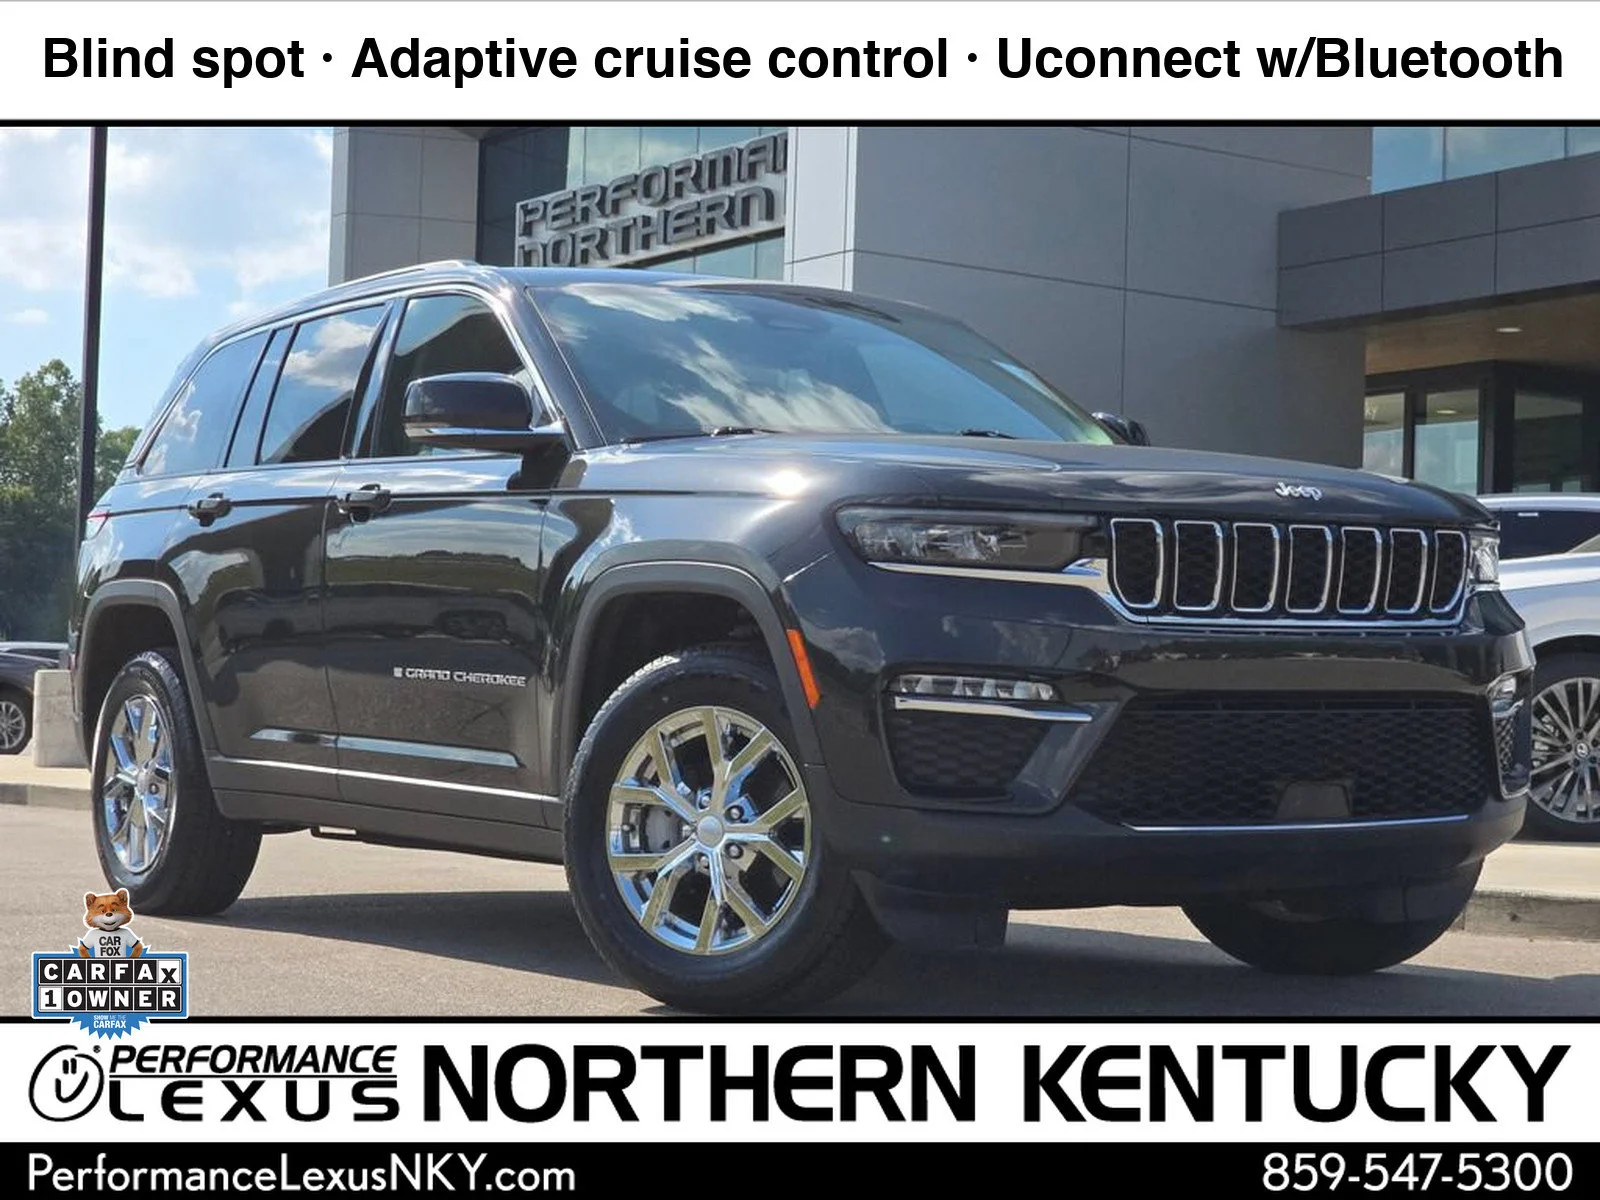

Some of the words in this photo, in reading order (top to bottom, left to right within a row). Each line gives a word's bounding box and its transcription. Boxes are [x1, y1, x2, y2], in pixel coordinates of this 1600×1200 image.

[518, 186, 774, 266] NORTHERN
[1275, 481, 1323, 501] Jeep
[405, 667, 450, 681] GRAND
[453, 671, 527, 687] CHEROKEE
